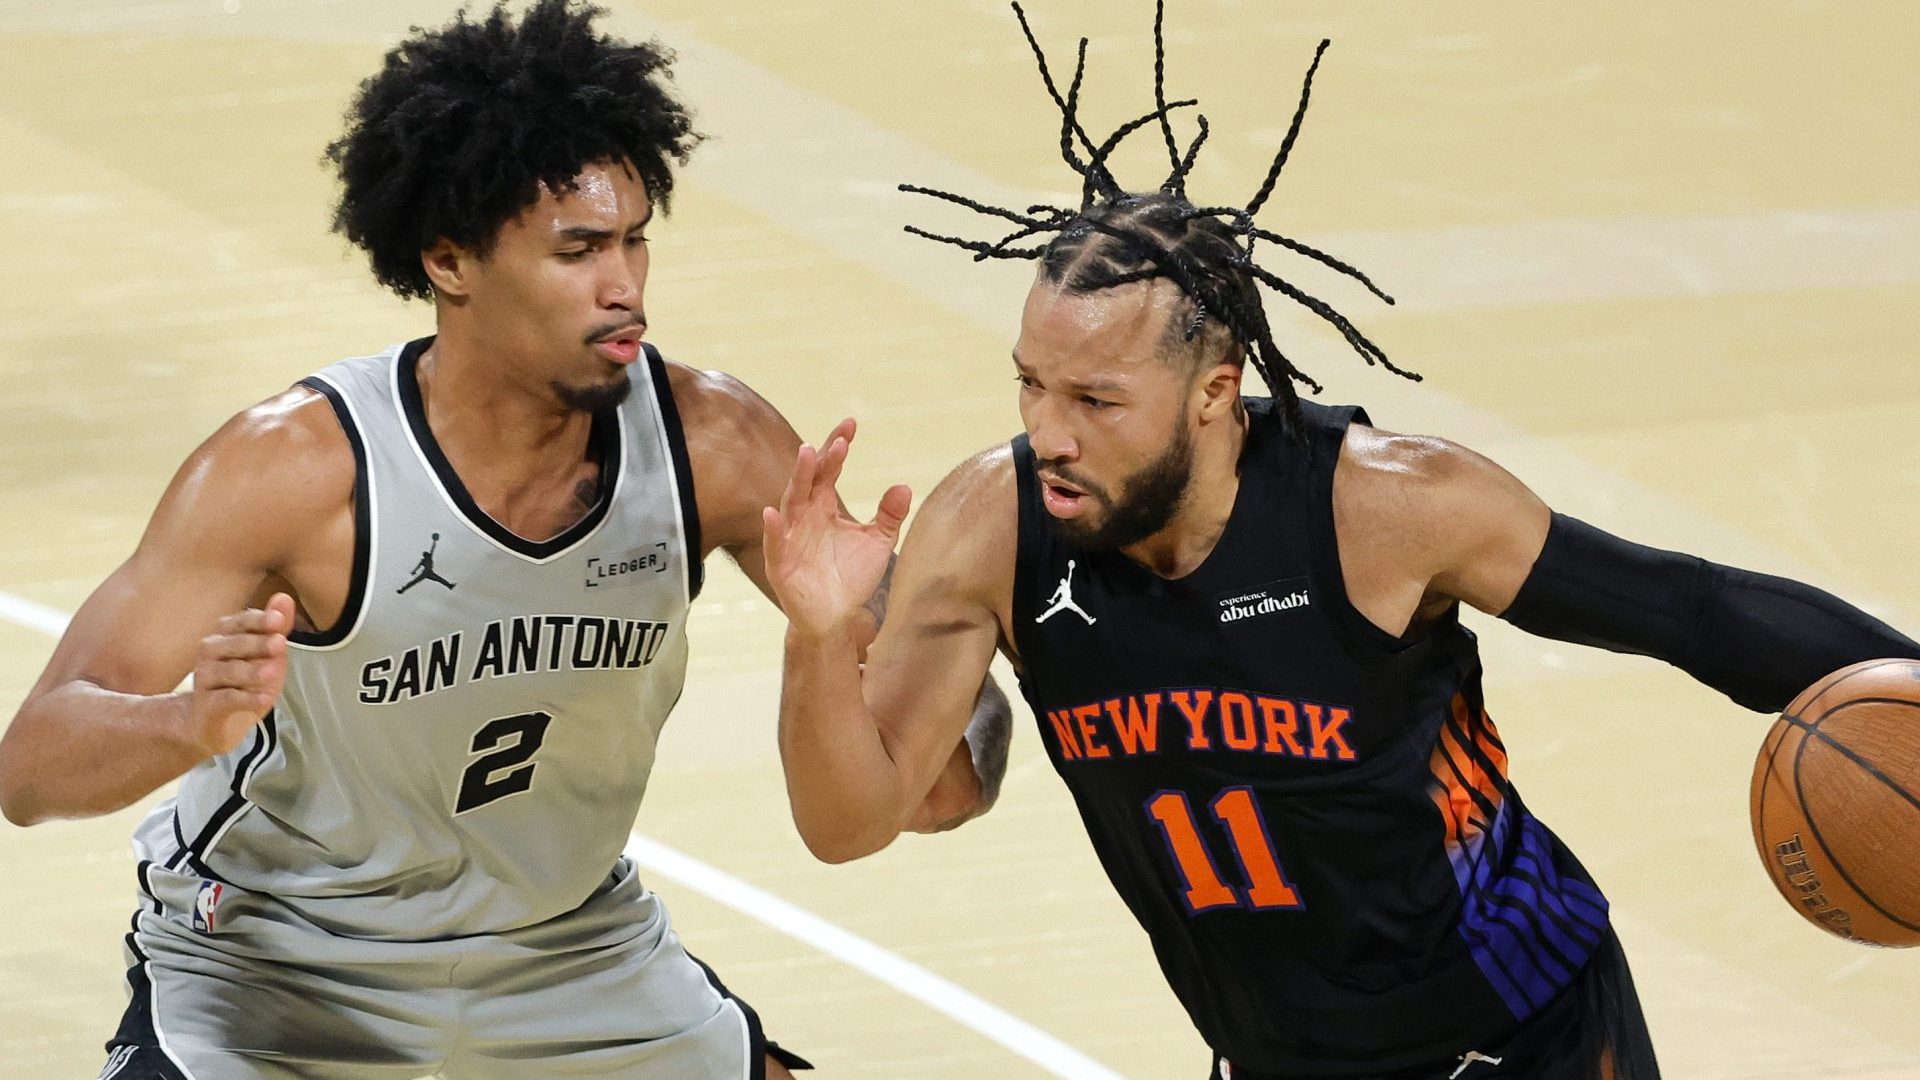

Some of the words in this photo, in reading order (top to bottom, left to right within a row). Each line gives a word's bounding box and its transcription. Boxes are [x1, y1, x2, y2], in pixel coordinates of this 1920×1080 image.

[598, 554, 657, 578] LEDGER
[1219, 591, 1267, 606] experience
[1220, 605, 1256, 623] abu
[1257, 590, 1310, 614] dhabi
[358, 631, 463, 705] SAN
[468, 614, 669, 683] ANTONIO
[1047, 693, 1161, 761] NEW
[1169, 688, 1356, 761] YORK
[452, 710, 554, 817] 2
[1144, 785, 1305, 916] 11
